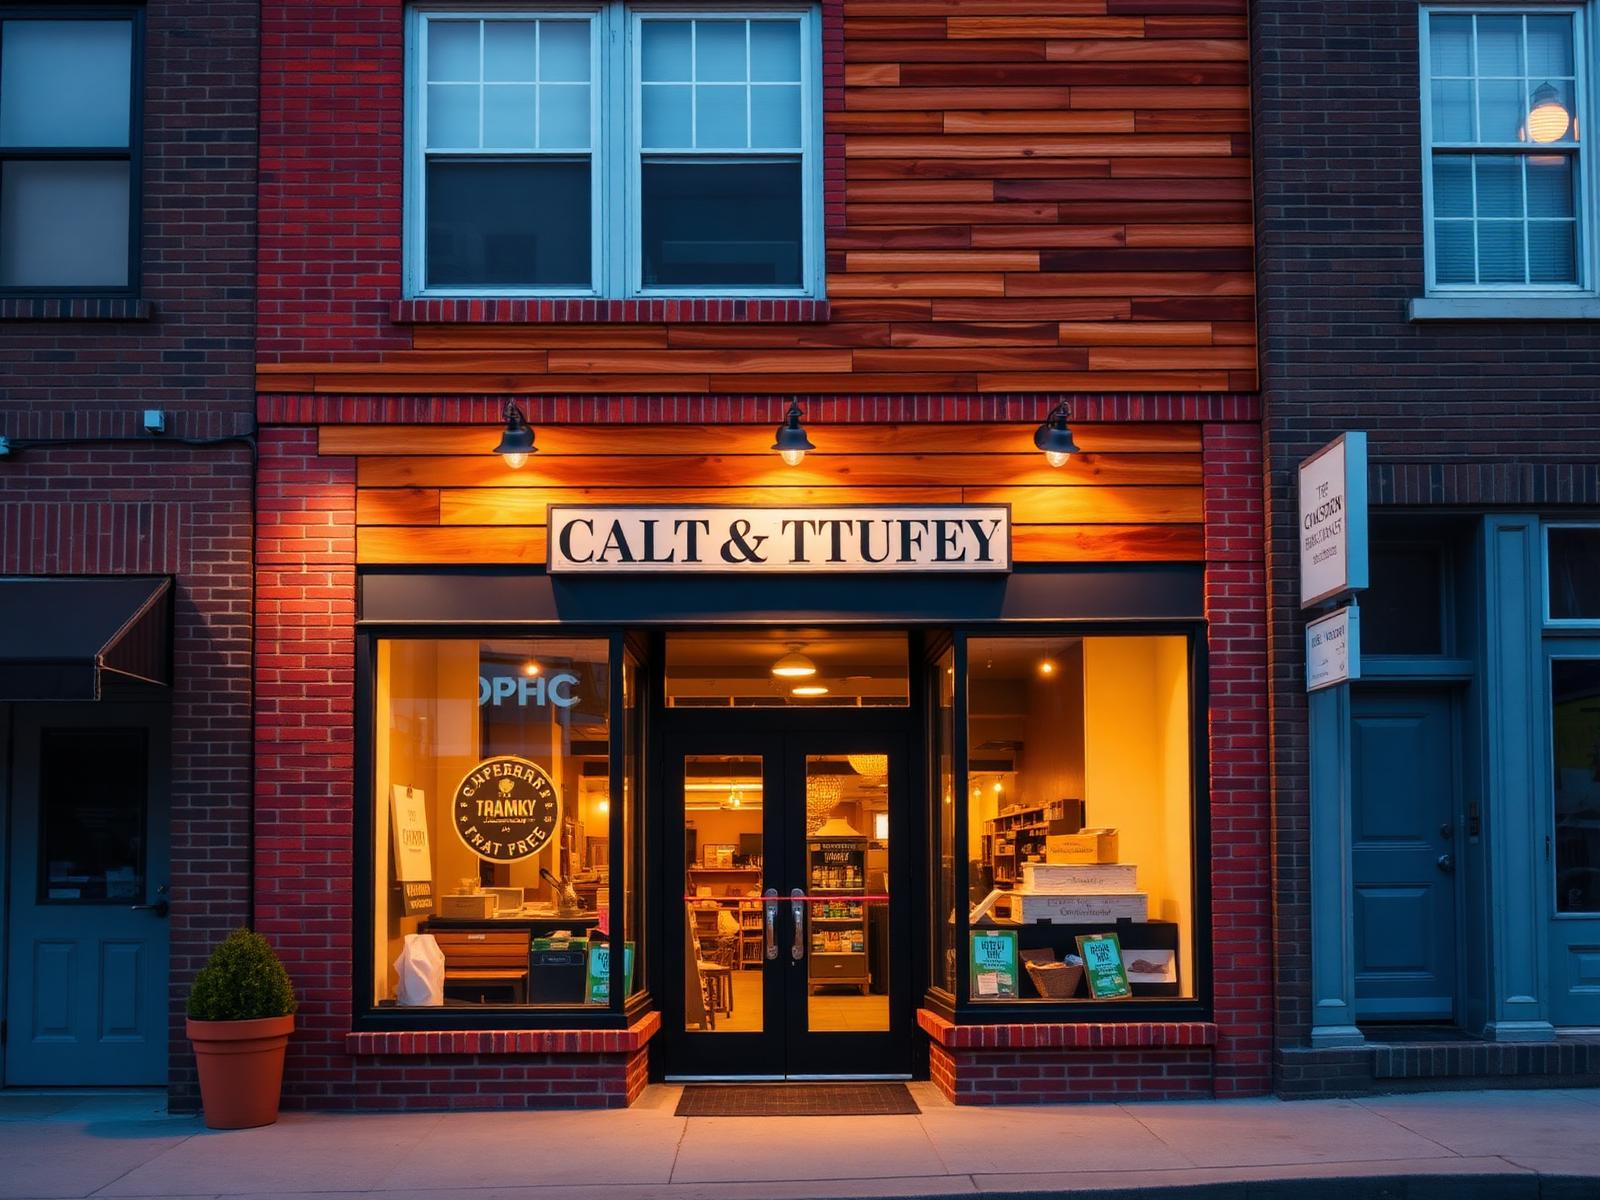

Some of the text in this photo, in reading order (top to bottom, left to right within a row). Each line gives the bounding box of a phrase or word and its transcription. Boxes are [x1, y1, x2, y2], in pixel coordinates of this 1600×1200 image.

[558, 519, 1001, 564] CALT & TTUFEY
